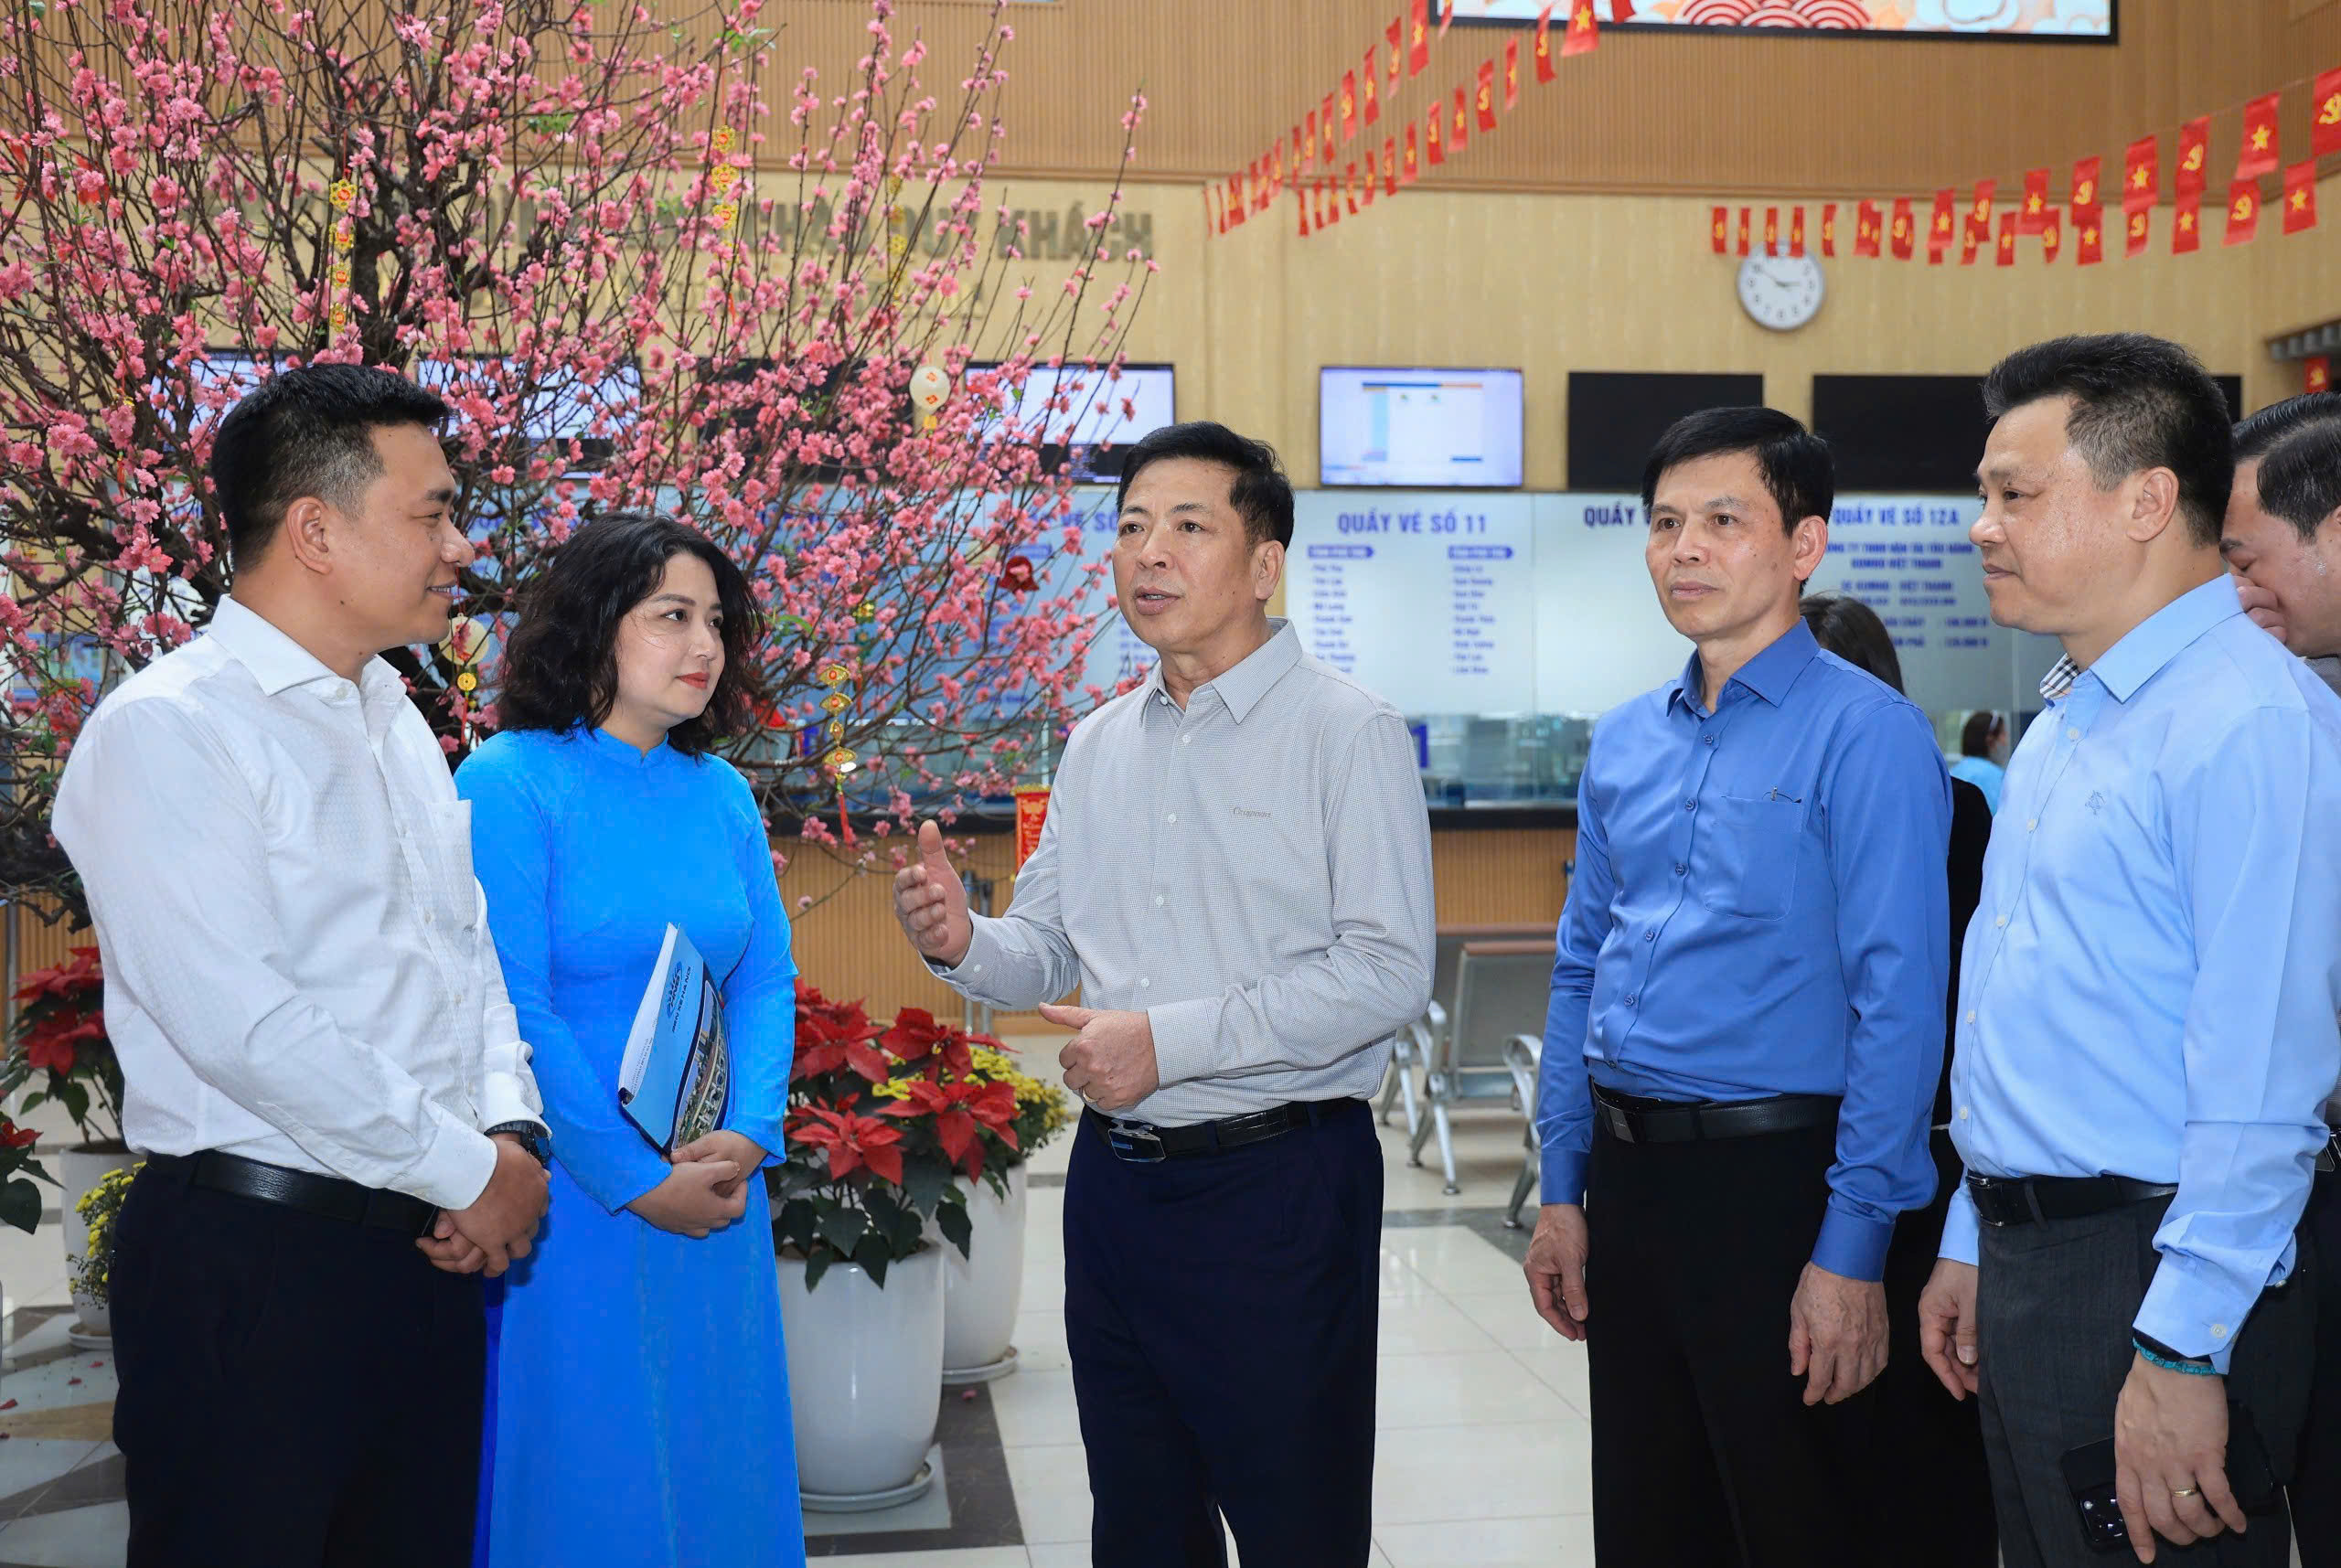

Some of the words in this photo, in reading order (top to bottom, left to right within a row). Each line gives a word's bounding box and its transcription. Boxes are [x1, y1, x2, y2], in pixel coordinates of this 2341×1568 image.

[1398, 507, 1423, 533] VÉ
[1430, 507, 1457, 533] SỐ
[1465, 514, 1487, 533] 11
